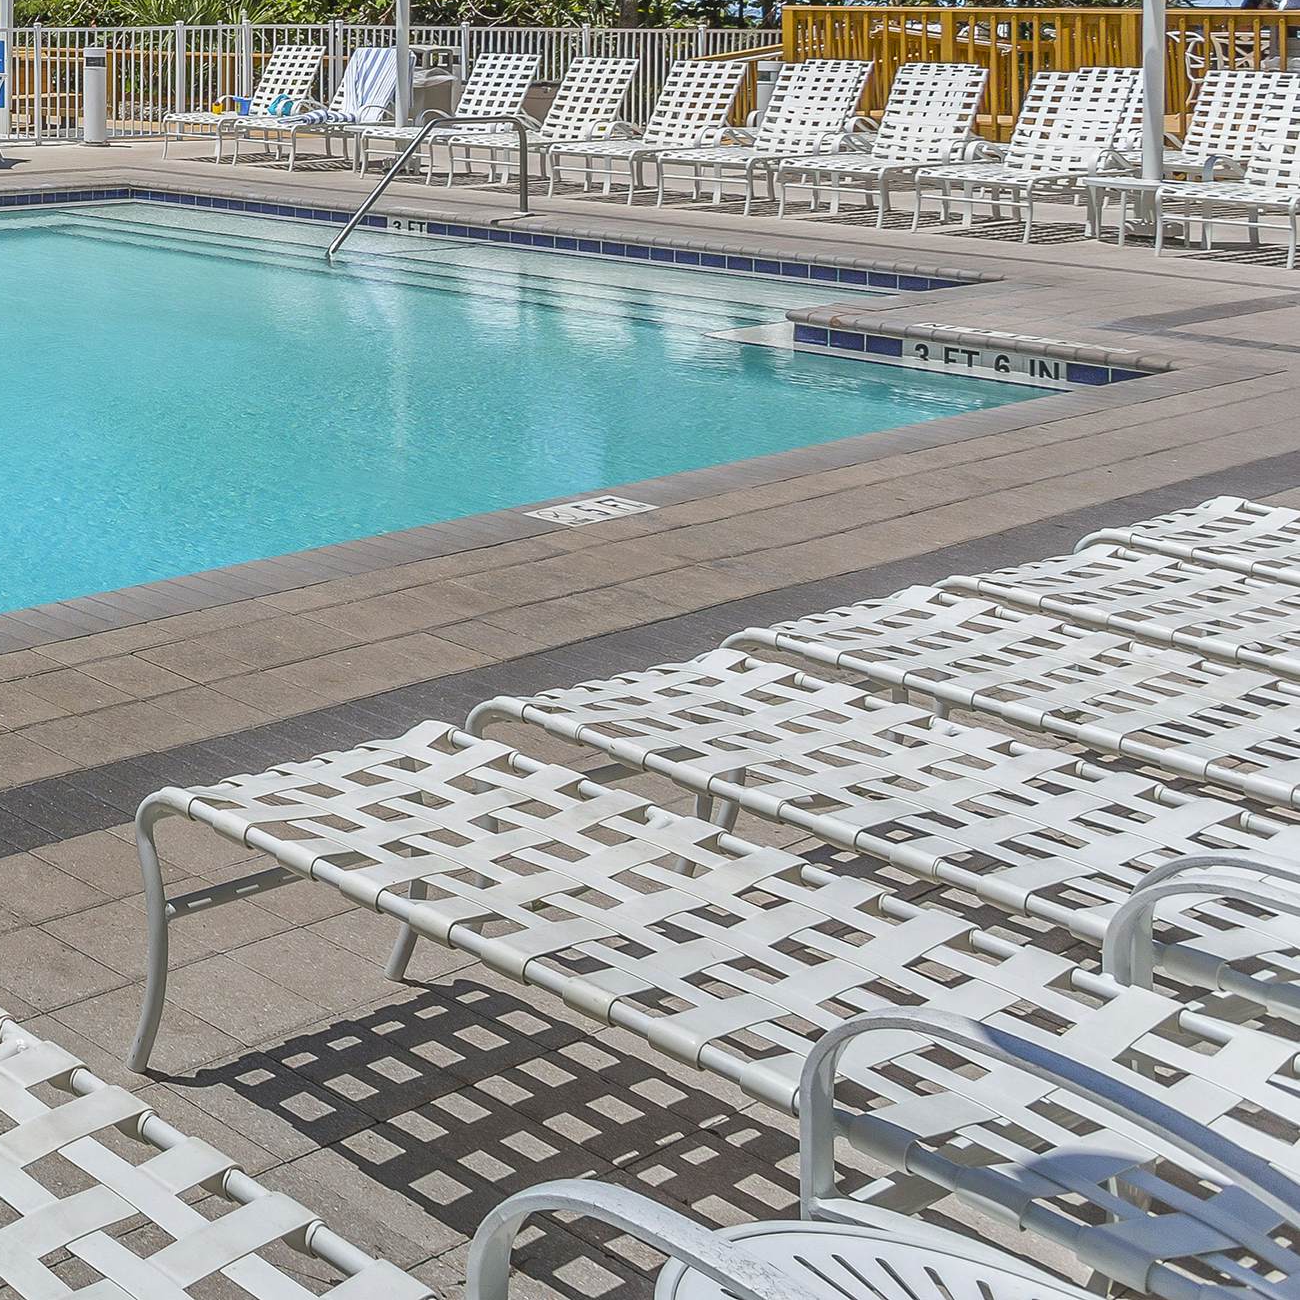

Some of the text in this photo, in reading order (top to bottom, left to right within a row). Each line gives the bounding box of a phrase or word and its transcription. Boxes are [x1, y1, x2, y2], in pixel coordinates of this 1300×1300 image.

[408, 221, 426, 232] FT
[944, 346, 980, 367] FT
[994, 354, 1010, 373] 6
[1029, 359, 1060, 380] IN
